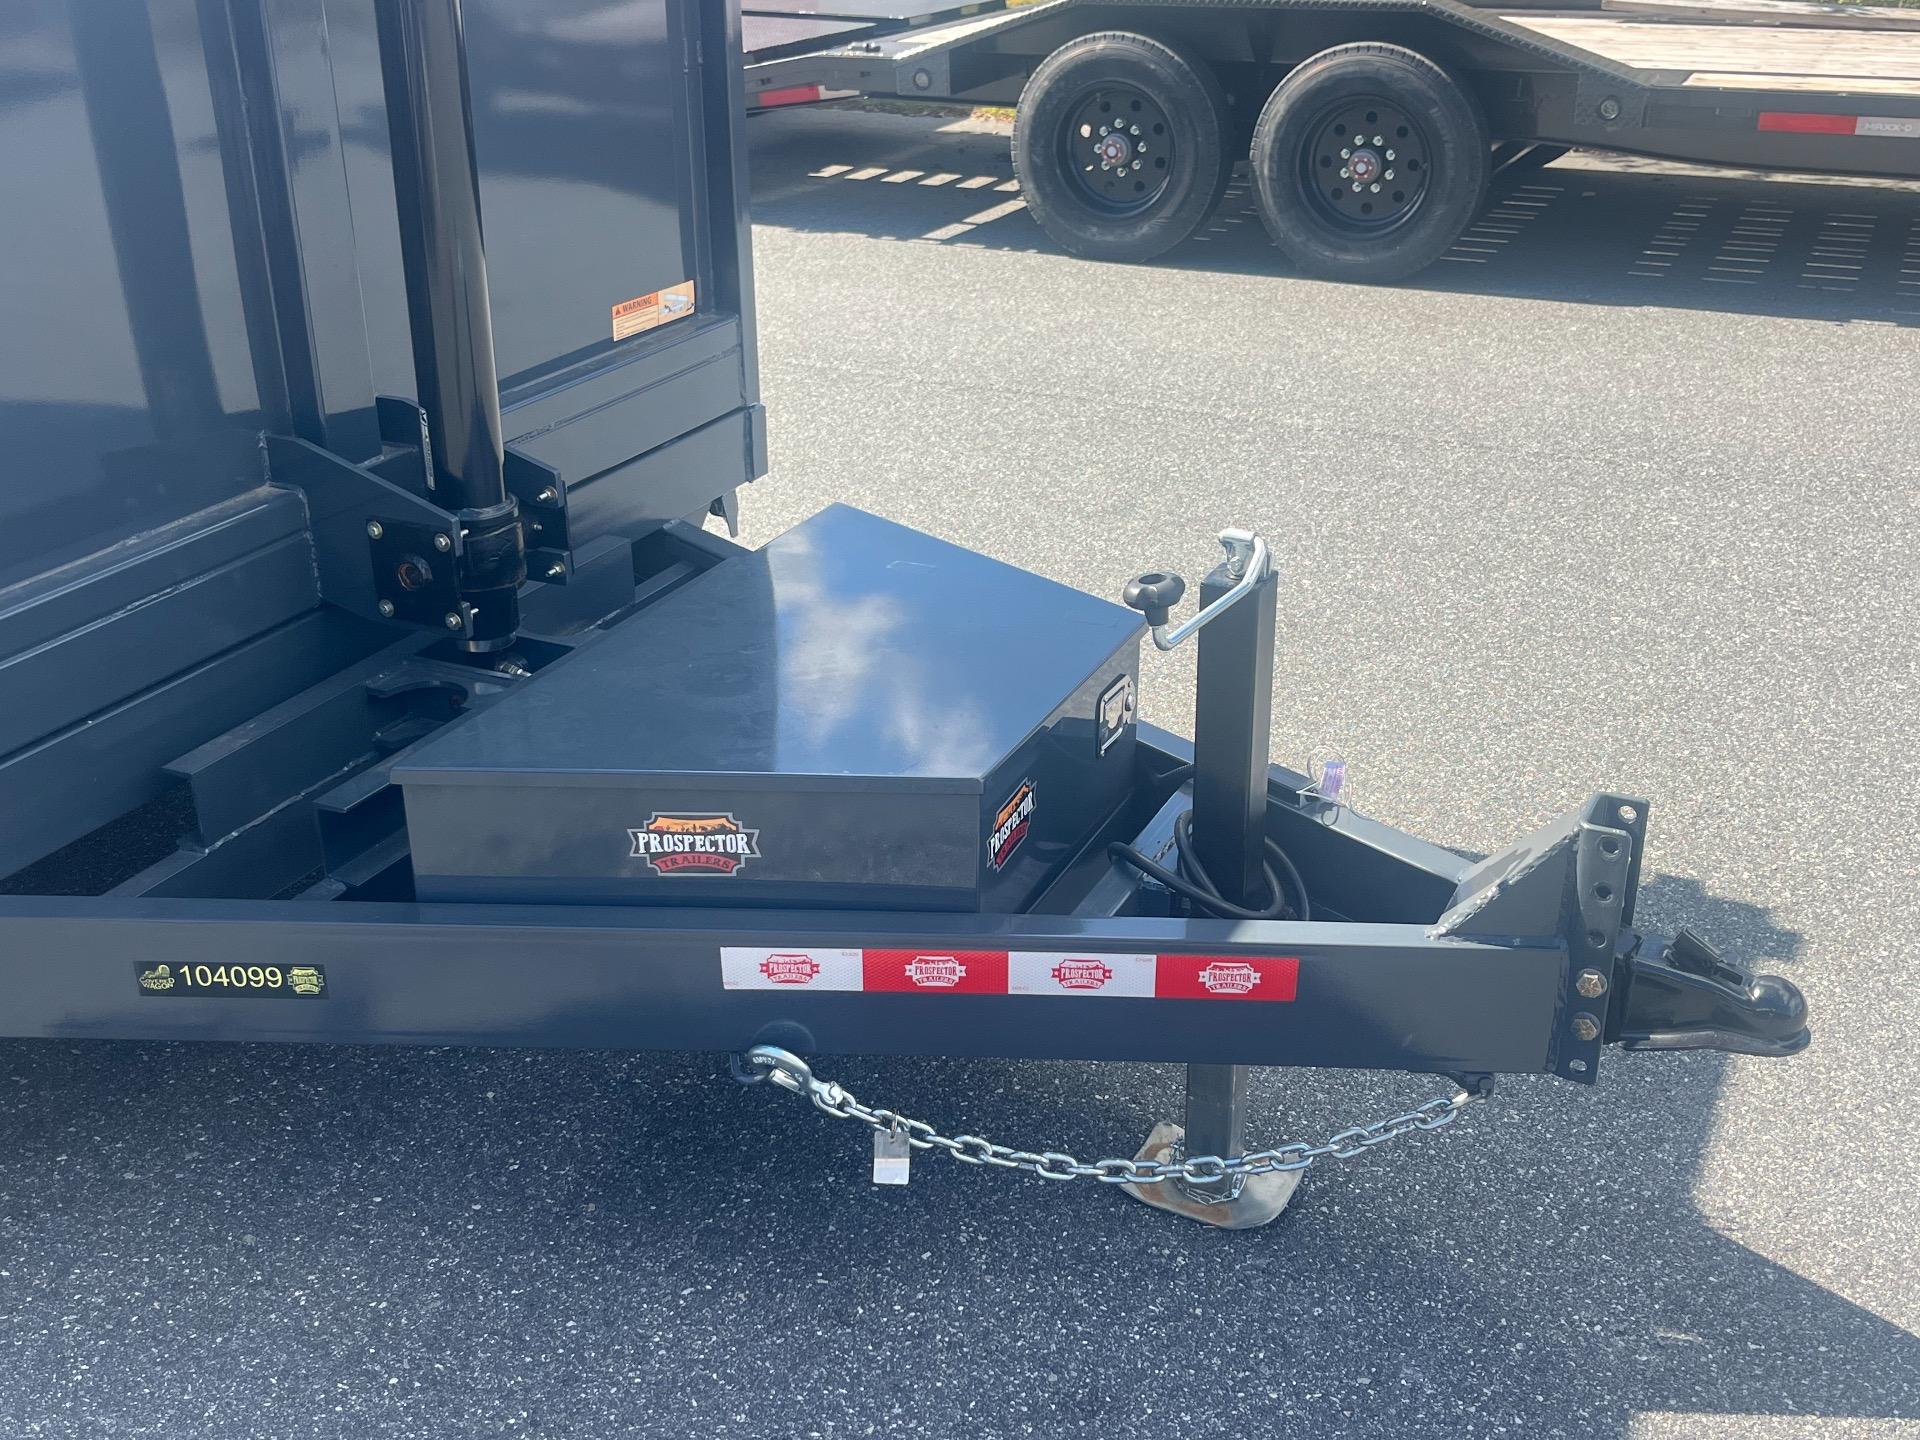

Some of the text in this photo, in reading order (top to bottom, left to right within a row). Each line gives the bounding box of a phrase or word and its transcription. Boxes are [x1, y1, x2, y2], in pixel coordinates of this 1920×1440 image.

[622, 296, 653, 313] WARNING
[990, 791, 1034, 860] PROSPECTOR
[637, 832, 751, 854] PROSPECTOR
[660, 855, 731, 869] TRAILERS
[768, 963, 812, 974] PROSPECTOR
[914, 966, 958, 976] PROSPECTOR
[1060, 967, 1105, 980] PROSPECTOR
[179, 964, 283, 988] 104099
[1208, 971, 1252, 983] PROSPECTOR
